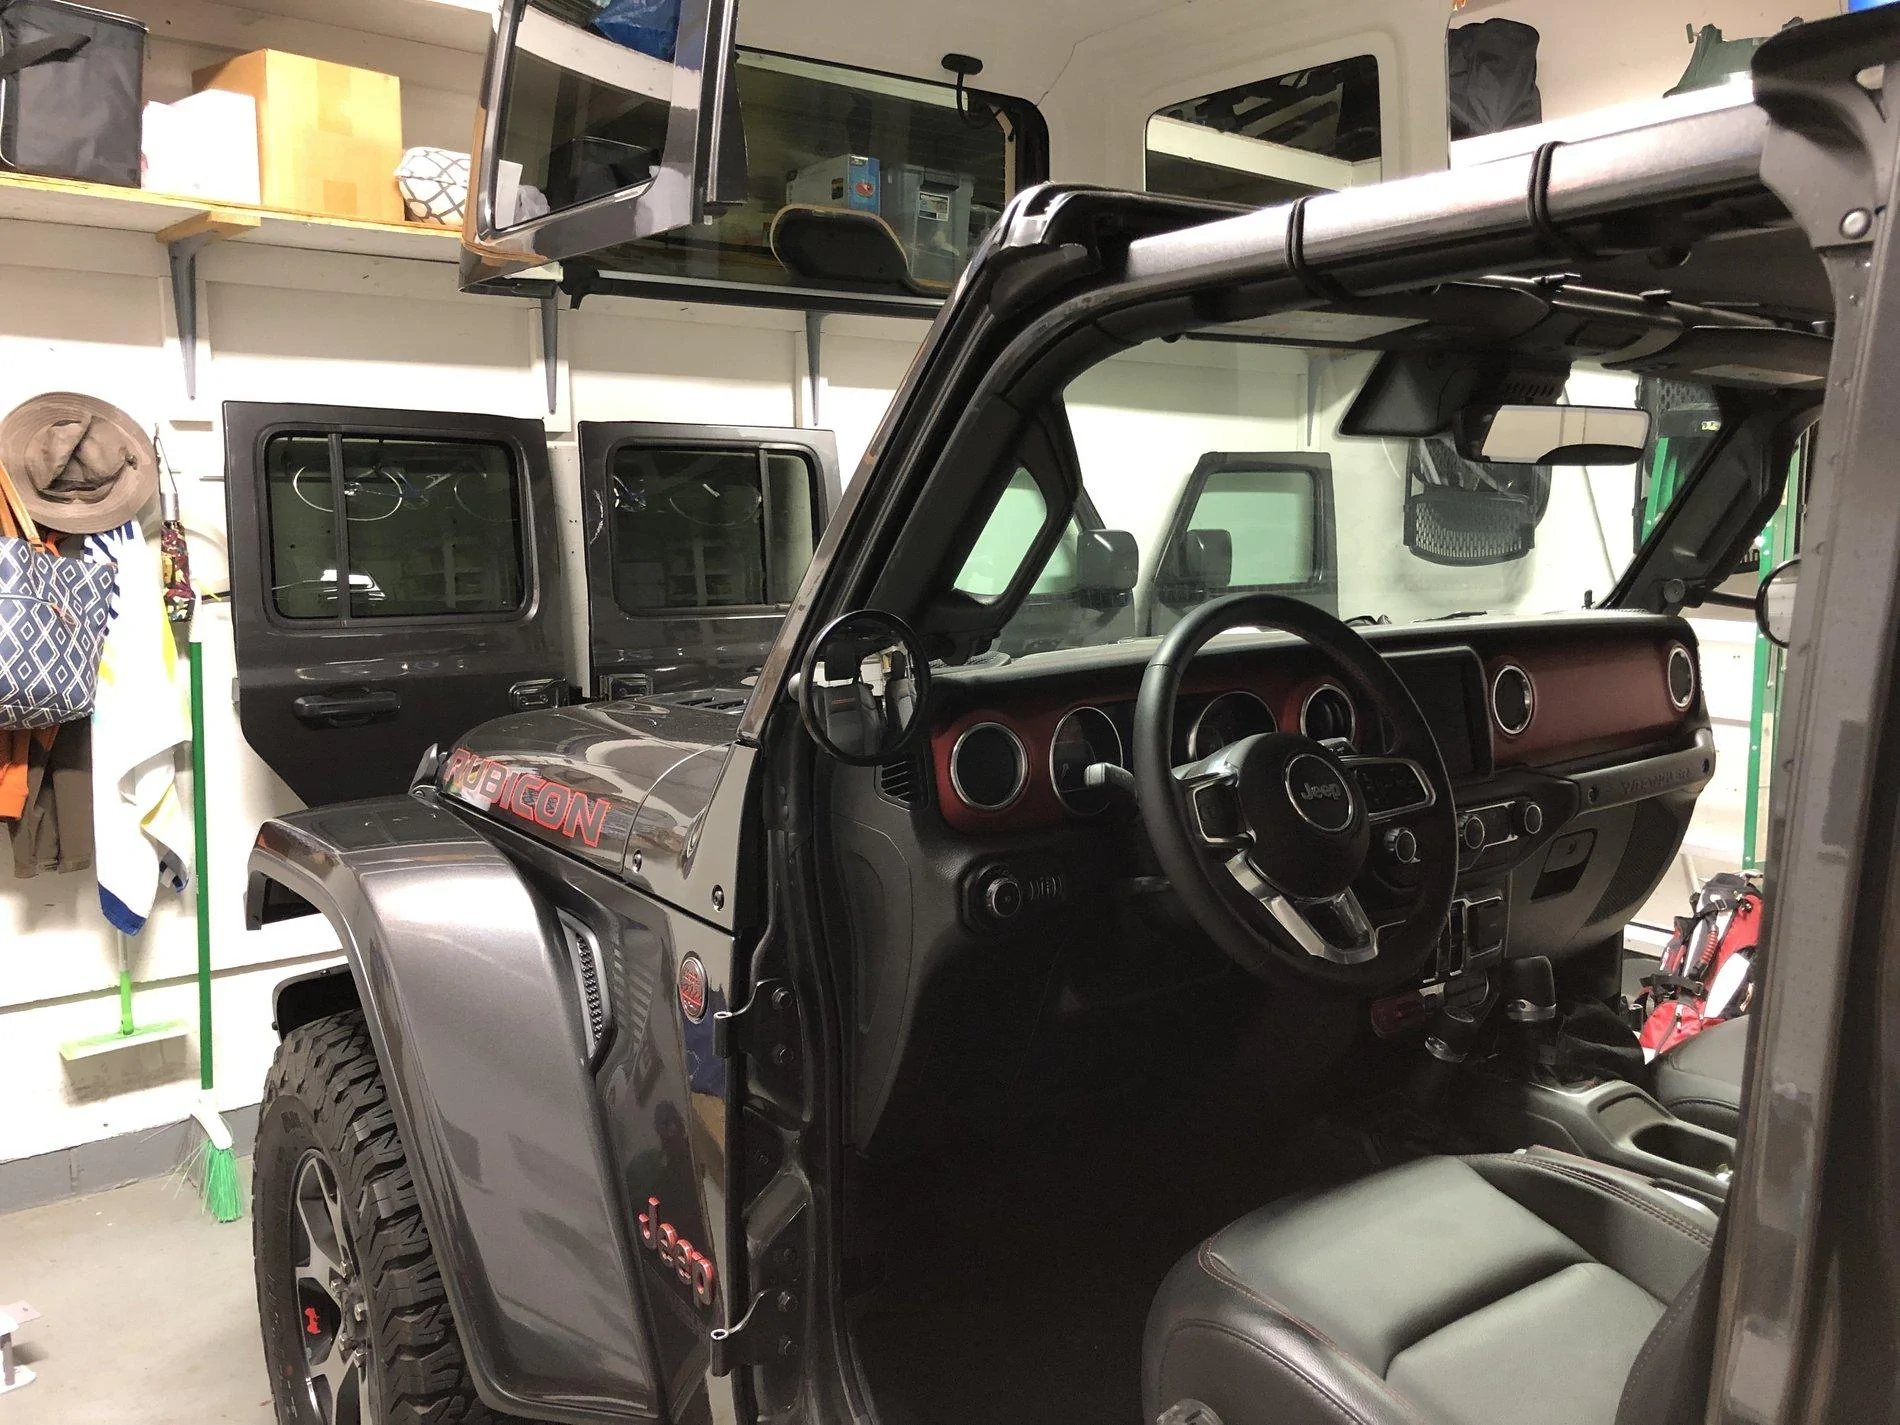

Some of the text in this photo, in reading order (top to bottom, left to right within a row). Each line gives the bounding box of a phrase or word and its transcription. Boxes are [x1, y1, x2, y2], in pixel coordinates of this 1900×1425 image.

[443, 747, 612, 848] RUBICON
[1300, 782, 1341, 800] Jeep
[638, 1196, 717, 1306] Jeep
